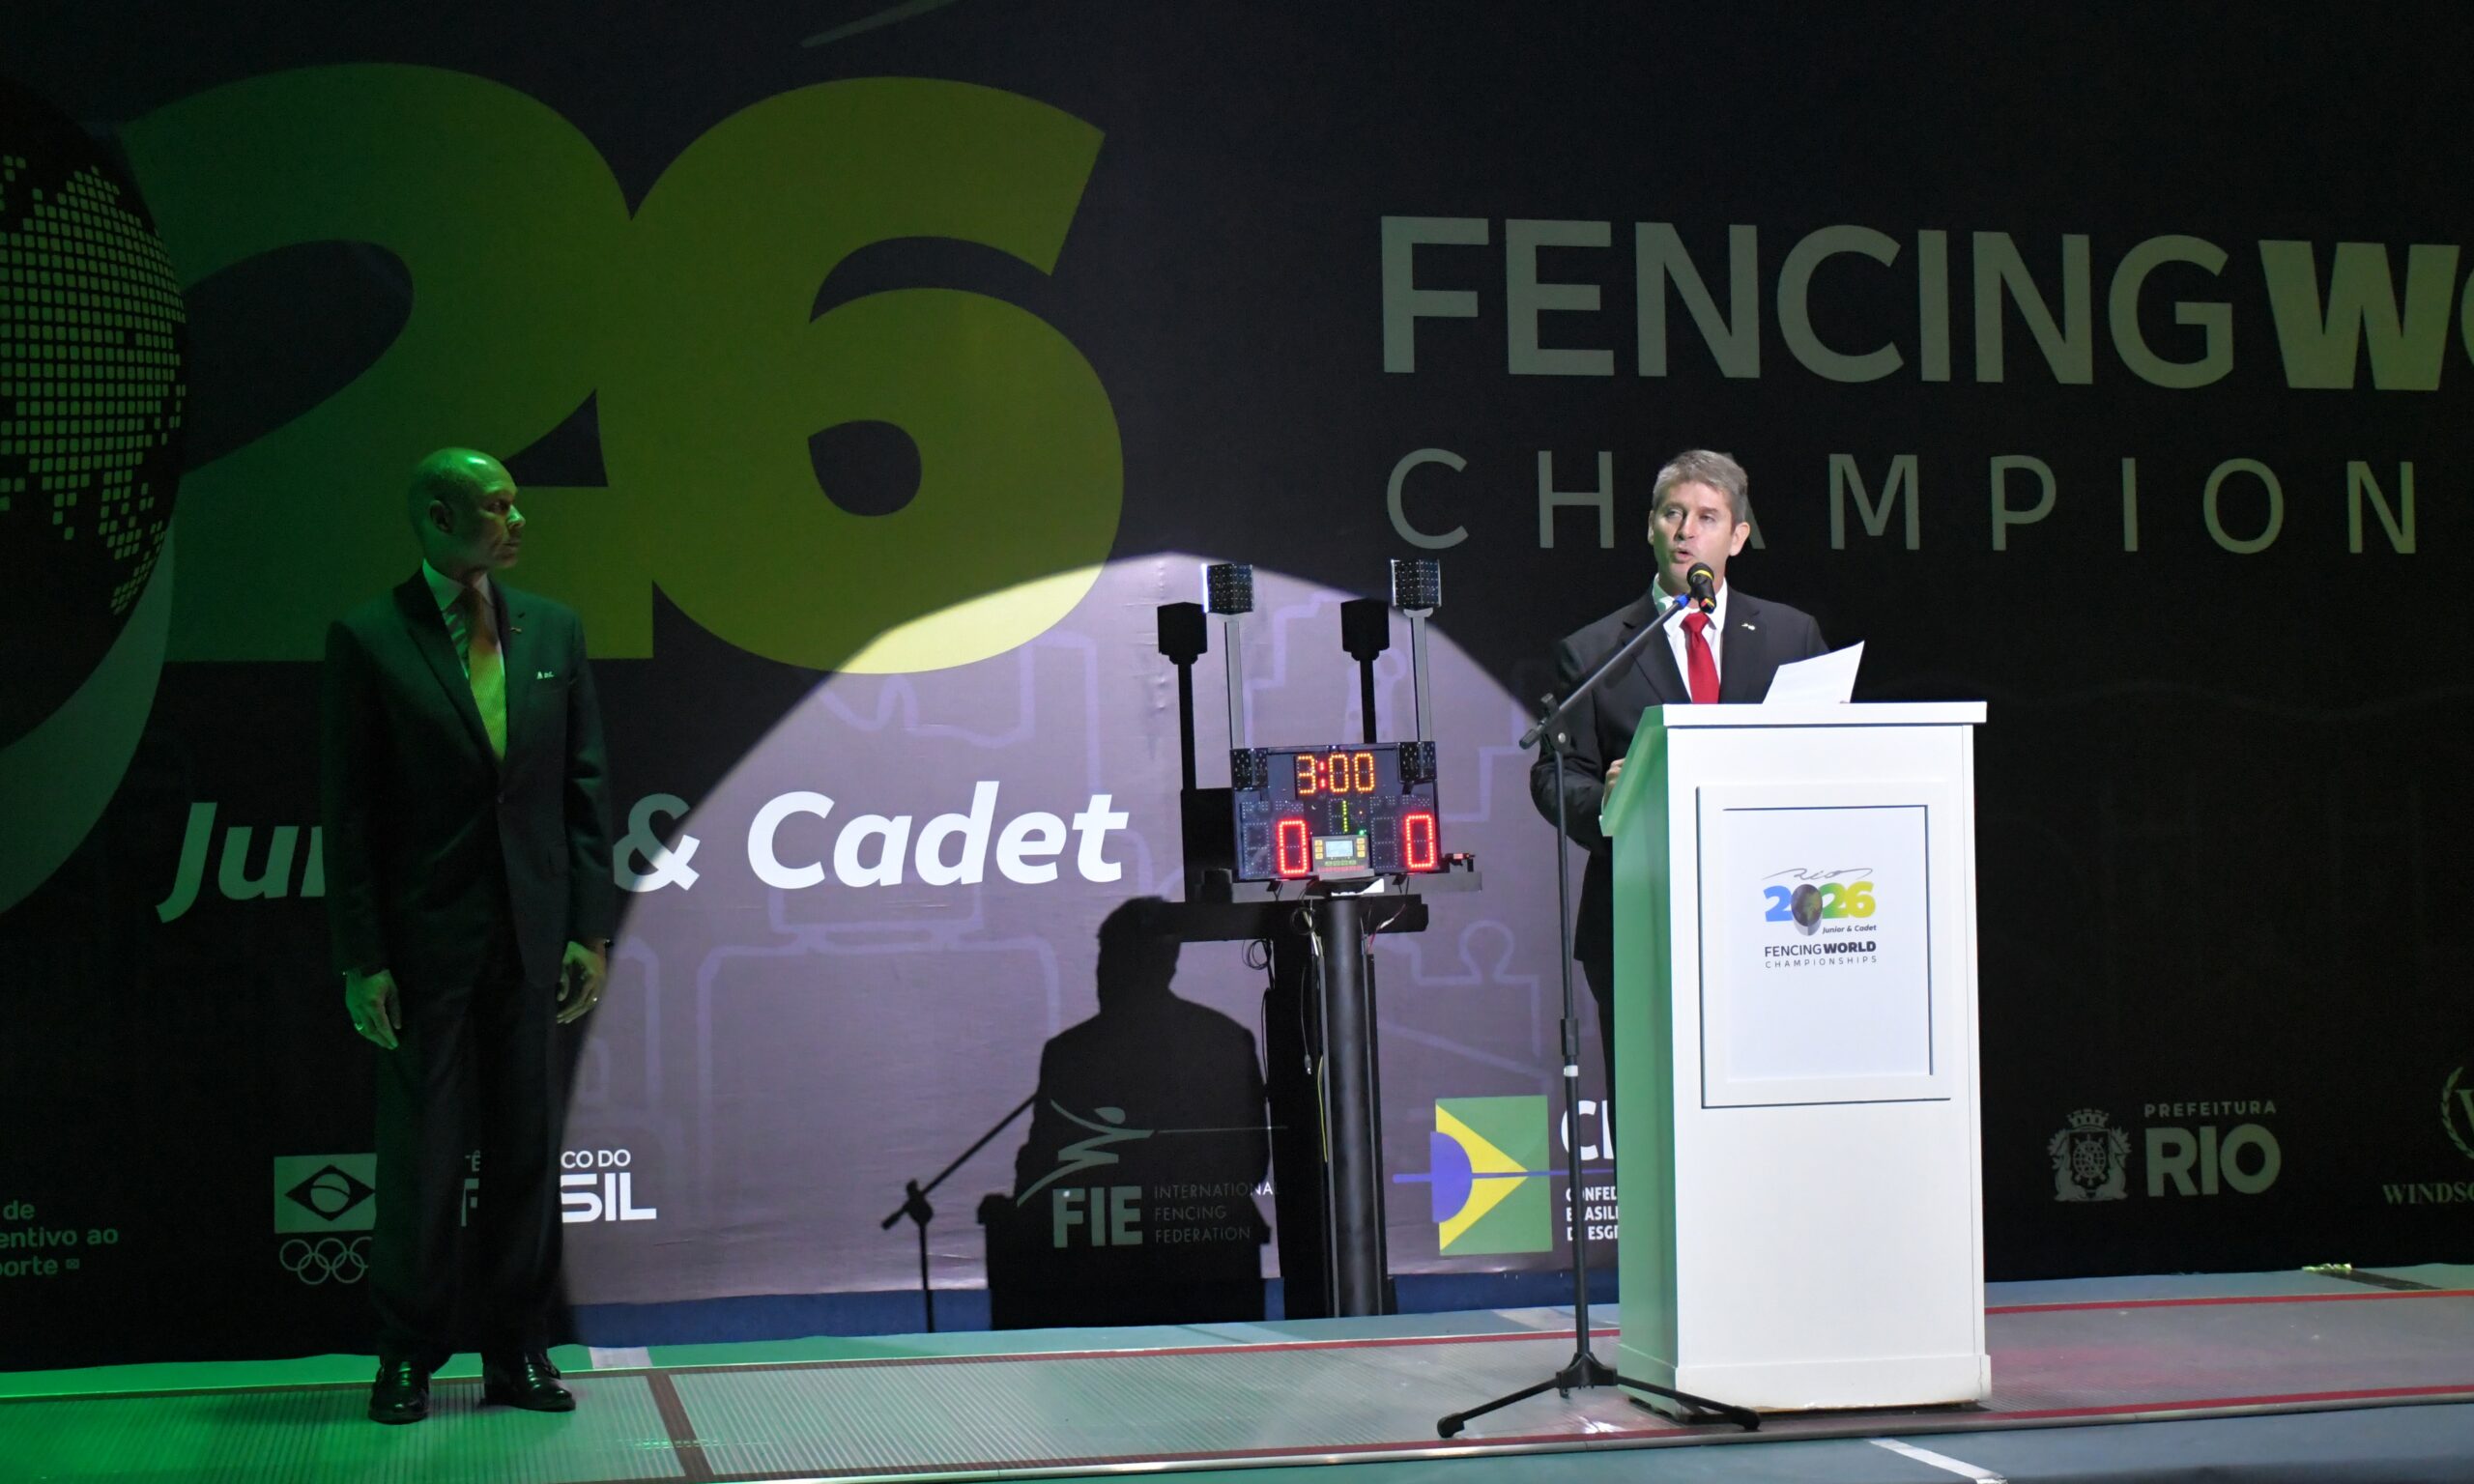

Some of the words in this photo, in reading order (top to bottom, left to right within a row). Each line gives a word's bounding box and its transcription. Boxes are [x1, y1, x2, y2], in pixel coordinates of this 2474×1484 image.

[1381, 215, 2234, 389] FENCING
[2258, 239, 2474, 391] W
[1297, 753, 1375, 794] 3:00
[613, 792, 702, 893] &
[747, 780, 1130, 890] Cadet
[1278, 818, 1309, 874] 0
[1405, 813, 1436, 869] 0
[1763, 880, 1877, 927] 2026
[1823, 926, 1845, 934] Junior
[1855, 924, 1877, 932] Cadet
[1765, 944, 1822, 957] FENCING
[1824, 940, 1877, 955] WORLD
[1766, 955, 1877, 969] CHAMPIONSHIPS
[2144, 1100, 2277, 1118] PREFEITURA
[598, 1149, 631, 1167] DO
[2144, 1123, 2282, 1197] RIO
[3, 1199, 36, 1220] de
[1052, 1185, 1143, 1248] FIE
[1155, 1205, 1227, 1221] FENCING
[86, 1228, 119, 1245] ao
[1155, 1226, 1251, 1243] FEDERATION
[0, 1255, 59, 1276] orte
